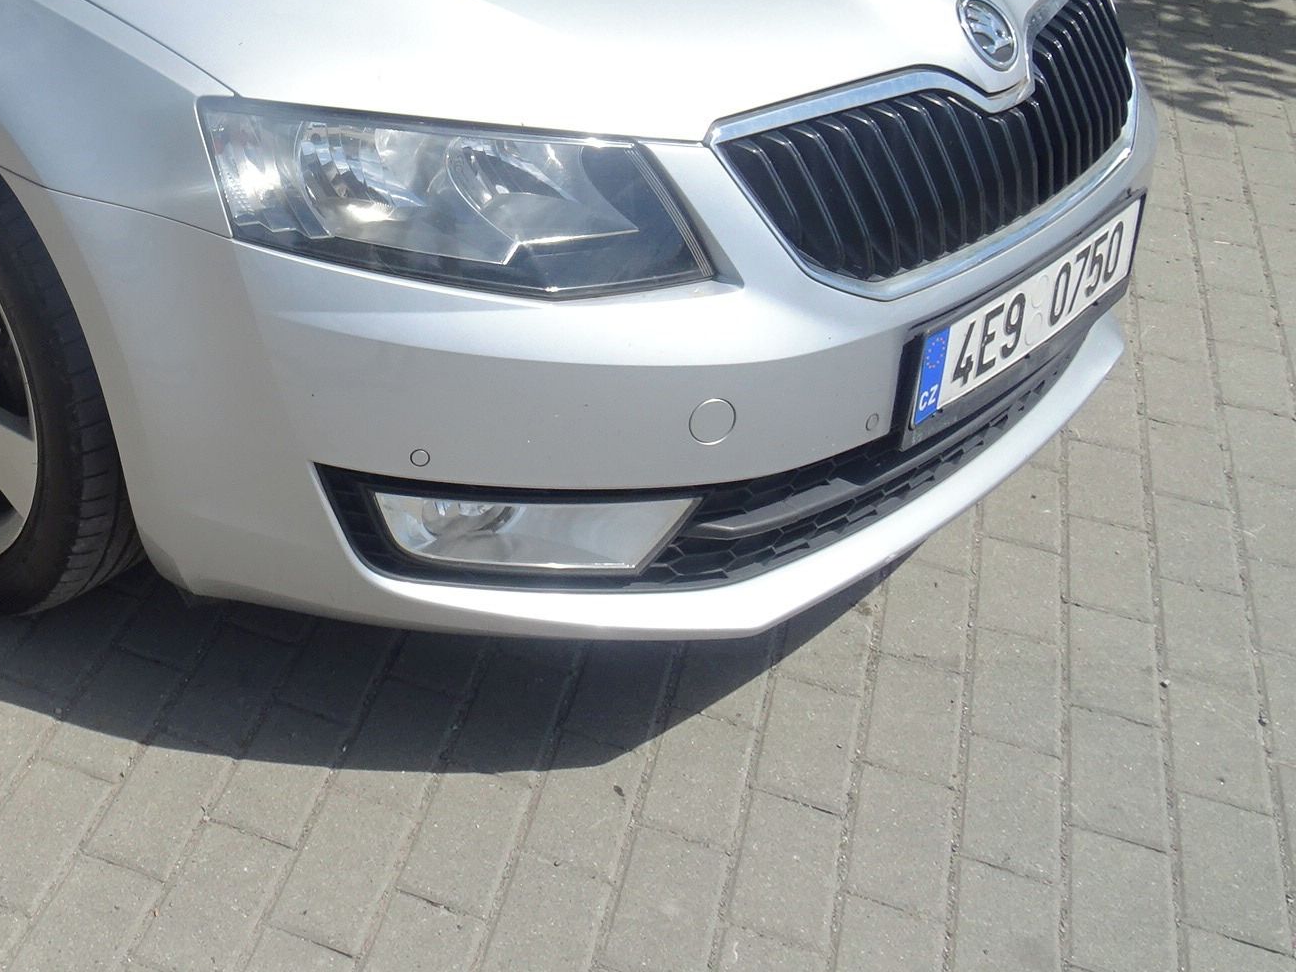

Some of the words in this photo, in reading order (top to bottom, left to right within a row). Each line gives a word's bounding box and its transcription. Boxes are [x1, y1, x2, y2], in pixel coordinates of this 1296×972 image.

[951, 292, 1026, 387] 4E9
[1048, 220, 1124, 327] 0750
[919, 386, 938, 412] CZ
